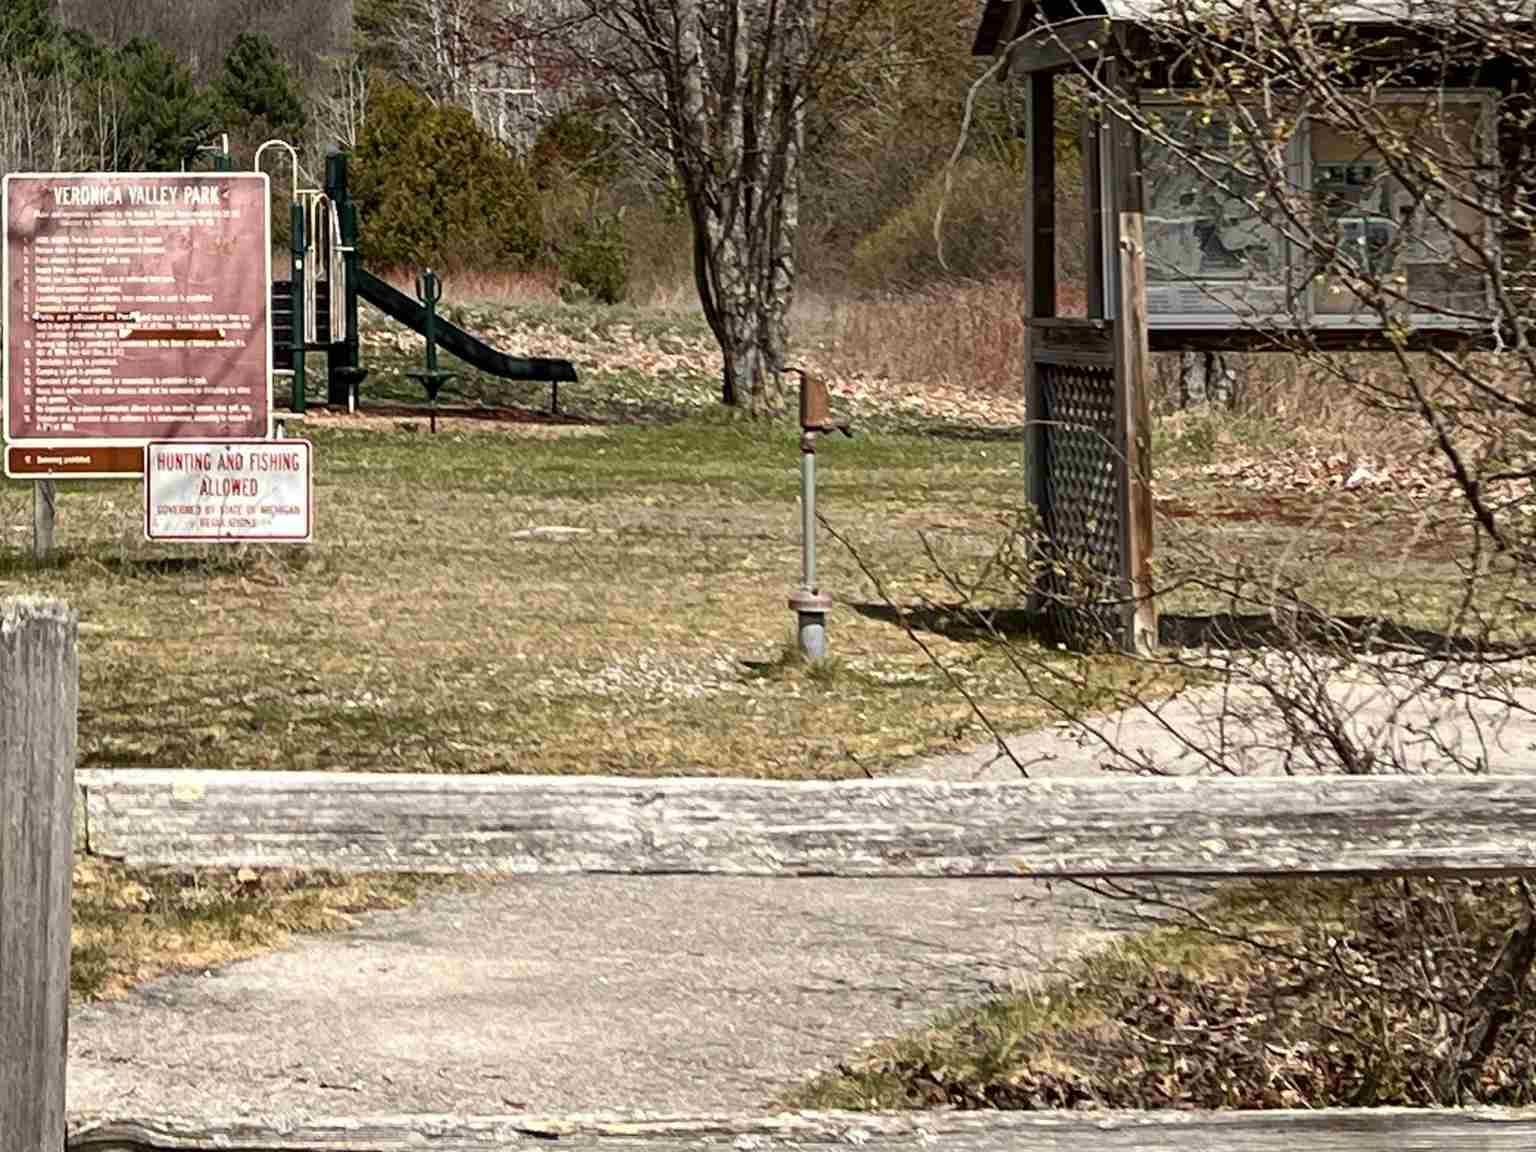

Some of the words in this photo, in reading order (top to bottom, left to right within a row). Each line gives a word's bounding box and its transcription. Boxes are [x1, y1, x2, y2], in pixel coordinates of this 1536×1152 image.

[53, 186, 122, 206] VERONICA
[129, 186, 177, 205] VALLEY
[184, 186, 219, 205] PARK
[157, 453, 211, 471] HUNTING
[217, 453, 243, 471] AND
[250, 453, 300, 471] FISHING
[199, 478, 258, 496] ALLOWED
